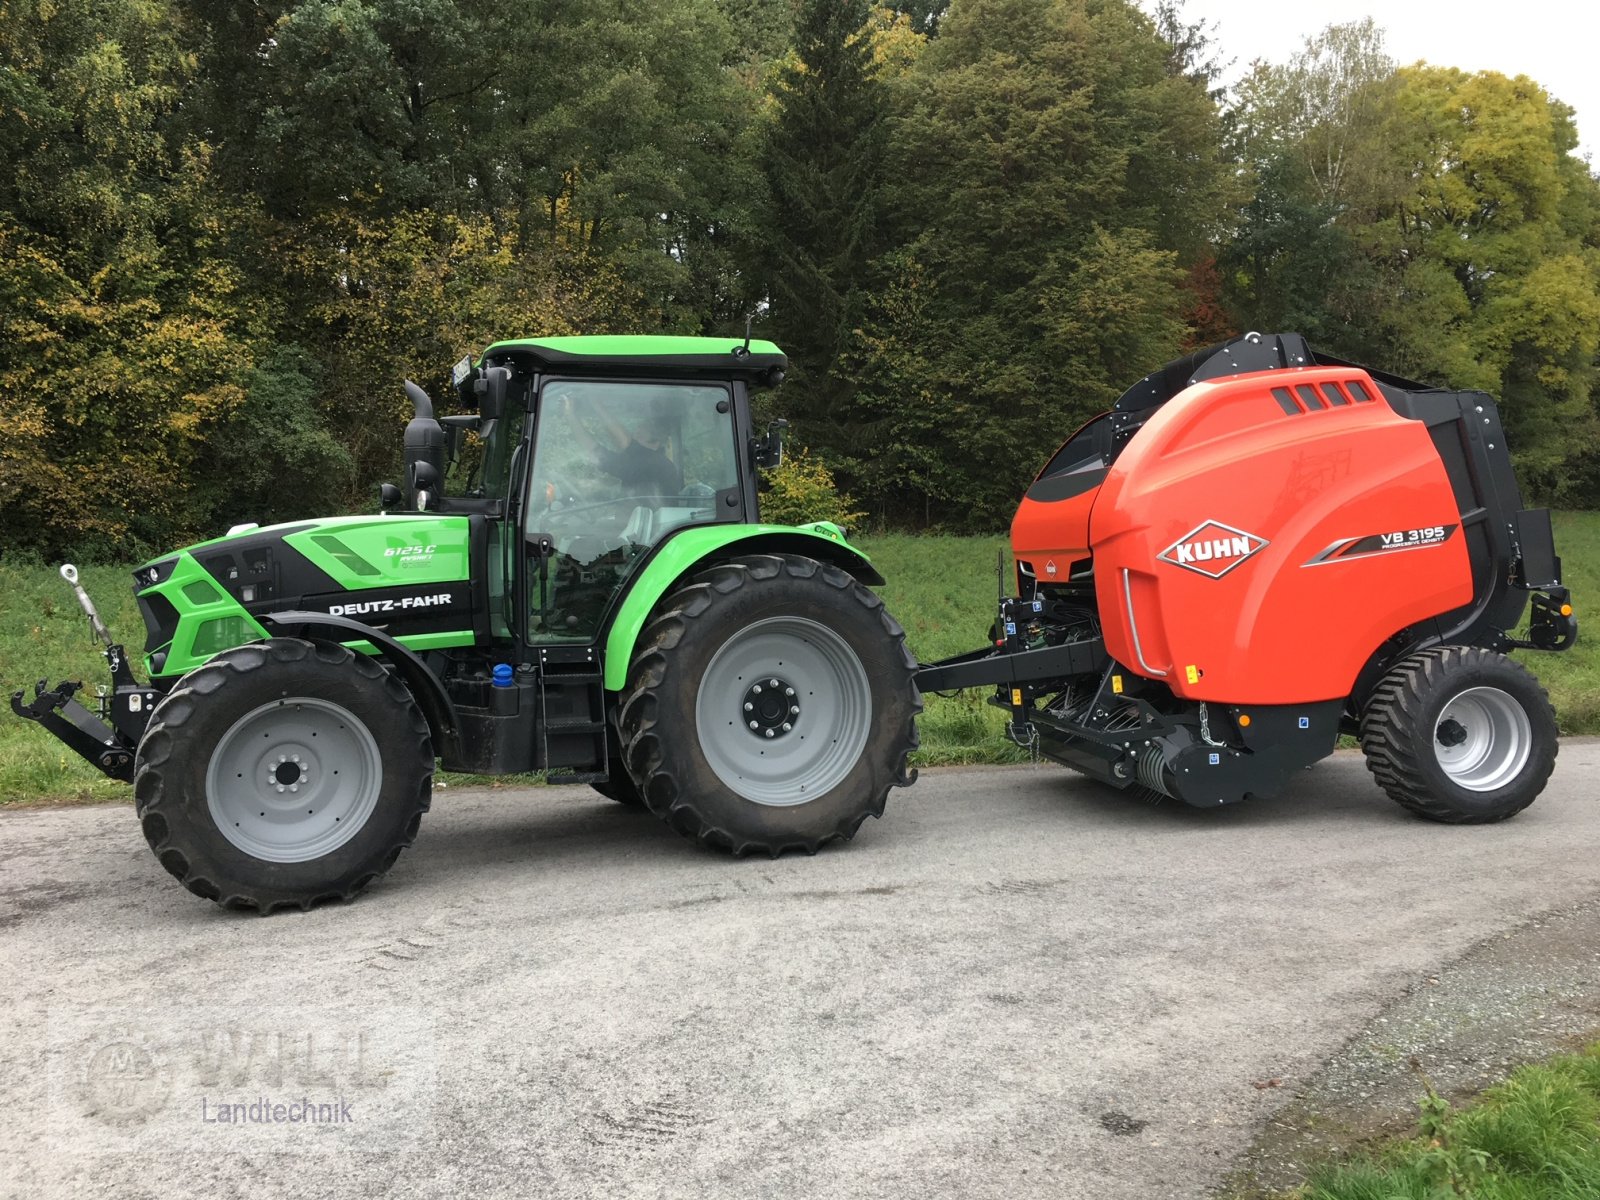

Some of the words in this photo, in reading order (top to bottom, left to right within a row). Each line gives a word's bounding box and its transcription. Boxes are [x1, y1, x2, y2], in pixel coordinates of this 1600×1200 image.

[1381, 532, 1404, 544] VB
[1408, 526, 1445, 541] 3195
[384, 545, 423, 557] 6125
[425, 544, 437, 554] C
[1176, 536, 1250, 563] KUHN
[1381, 540, 1420, 549] PROGRESSIVE
[329, 593, 452, 616] DEUTZ-FAHR
